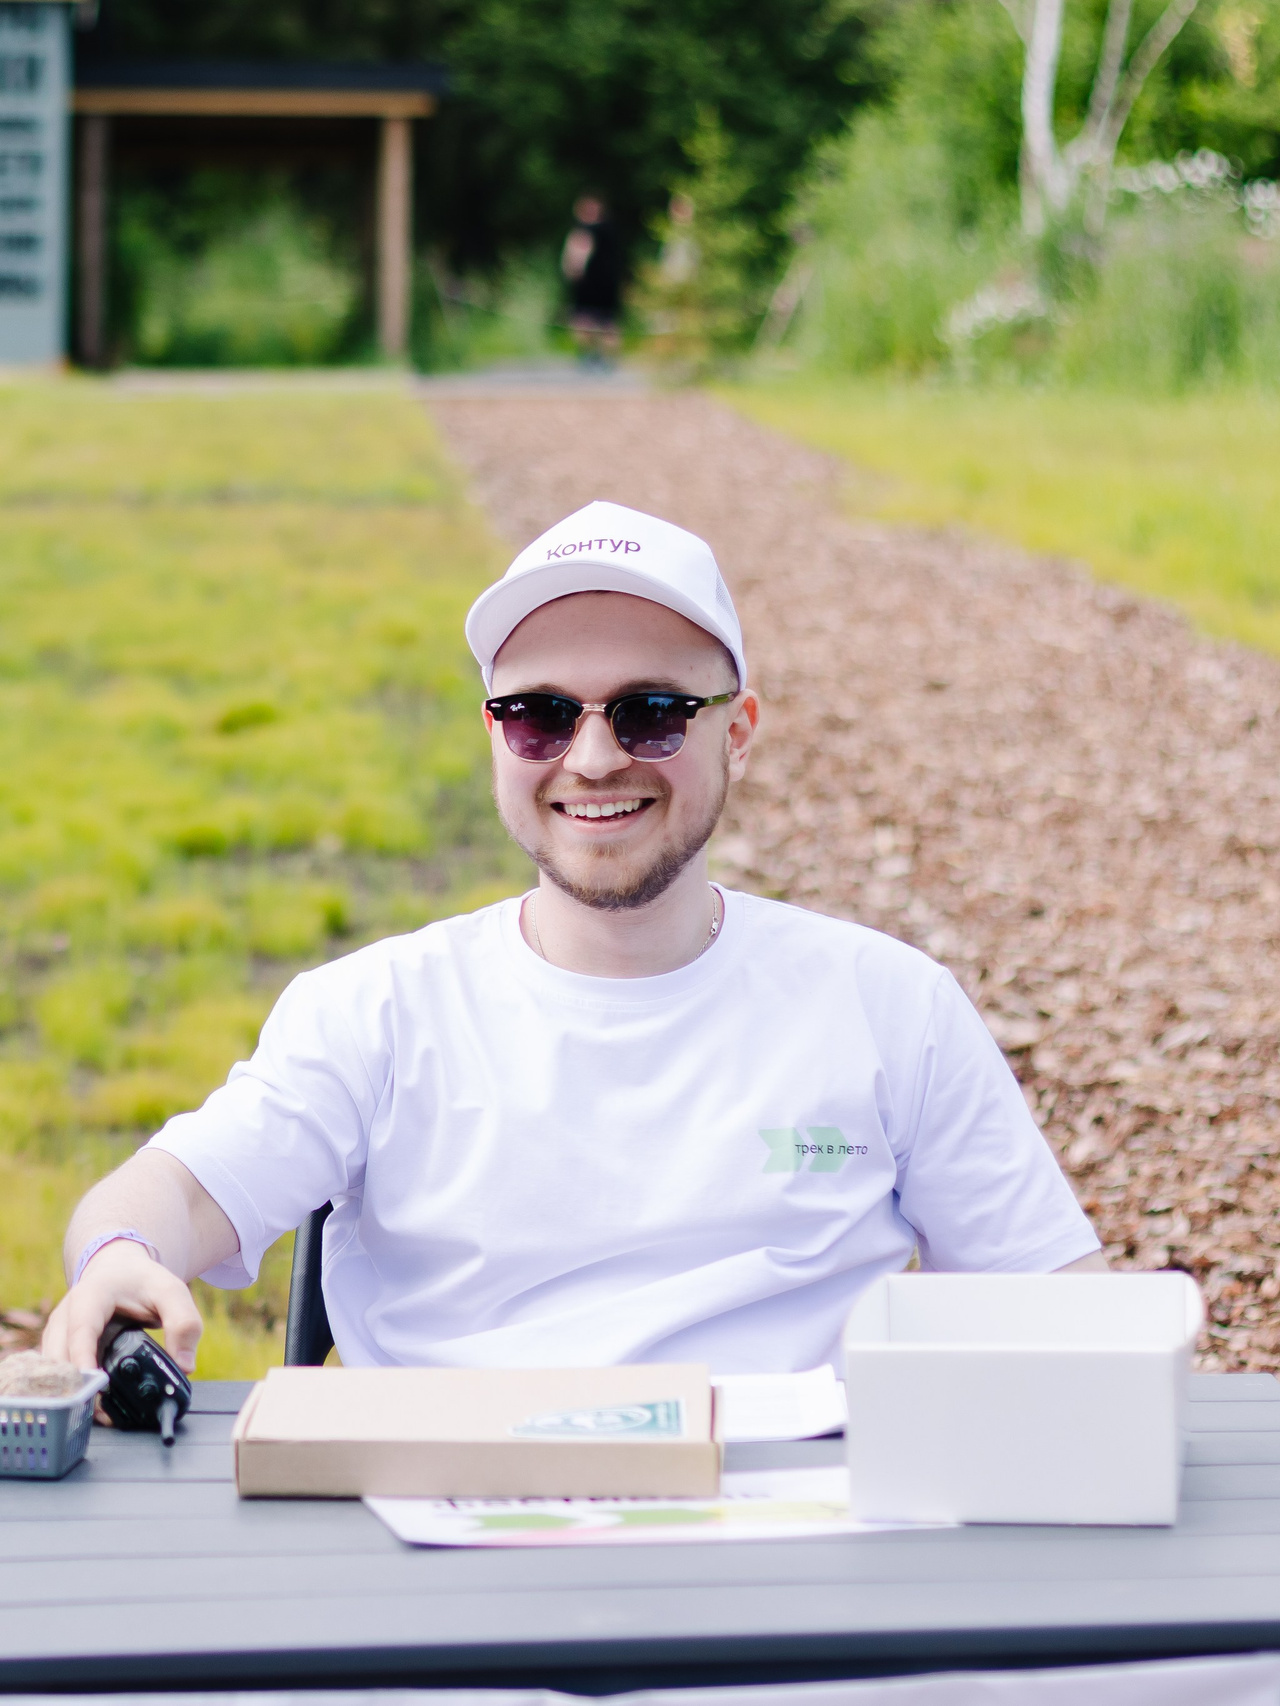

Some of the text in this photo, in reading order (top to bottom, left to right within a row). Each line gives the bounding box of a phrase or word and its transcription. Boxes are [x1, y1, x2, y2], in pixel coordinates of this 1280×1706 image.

[546, 538, 641, 560] Контур
[795, 1144, 869, 1157] трек в лето
